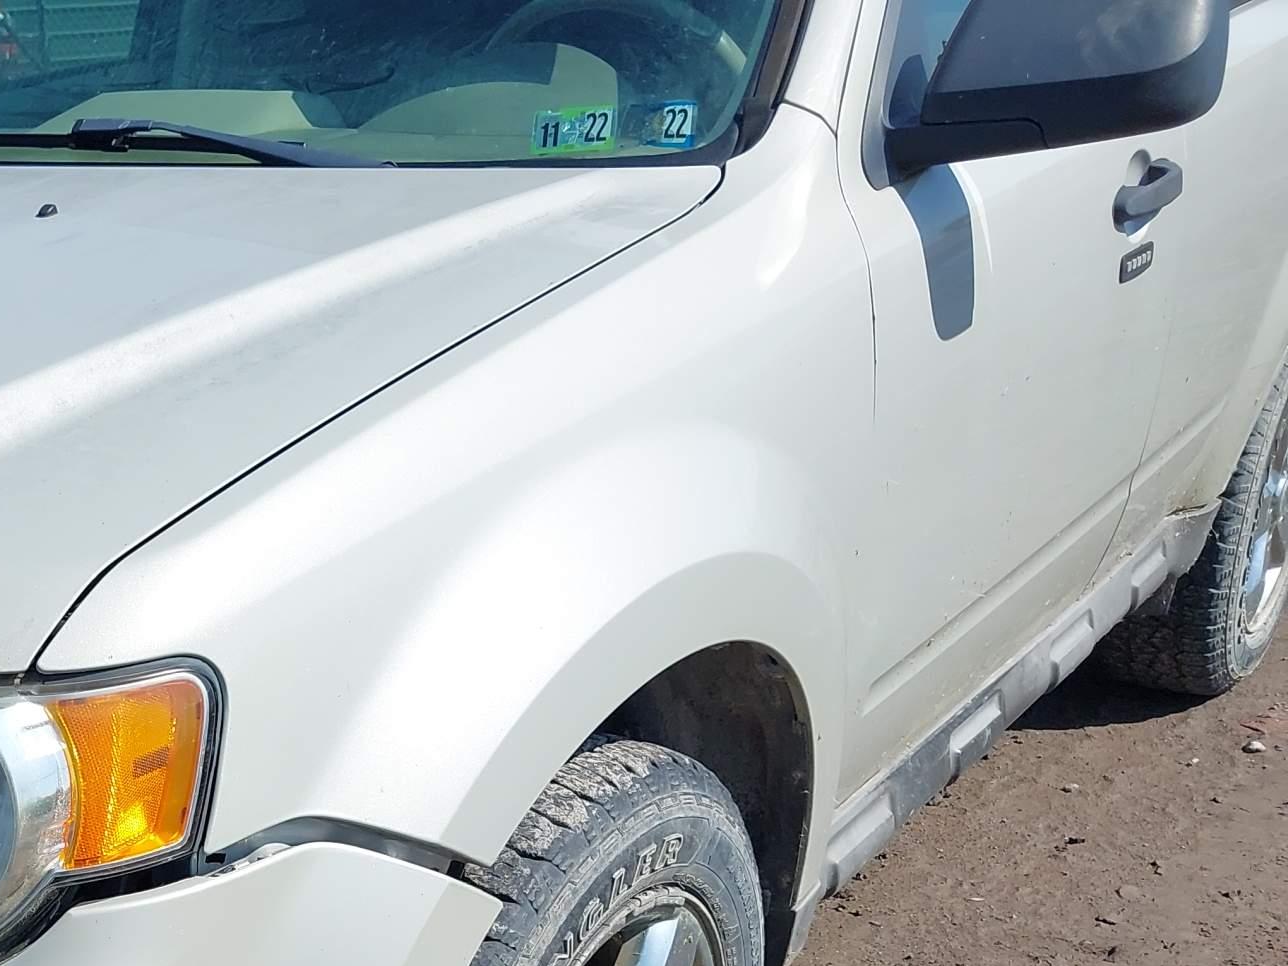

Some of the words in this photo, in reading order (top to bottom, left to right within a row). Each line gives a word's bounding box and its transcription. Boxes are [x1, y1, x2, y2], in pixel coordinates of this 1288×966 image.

[540, 121, 560, 148] 11
[583, 112, 609, 143] 22
[663, 108, 688, 139] 22
